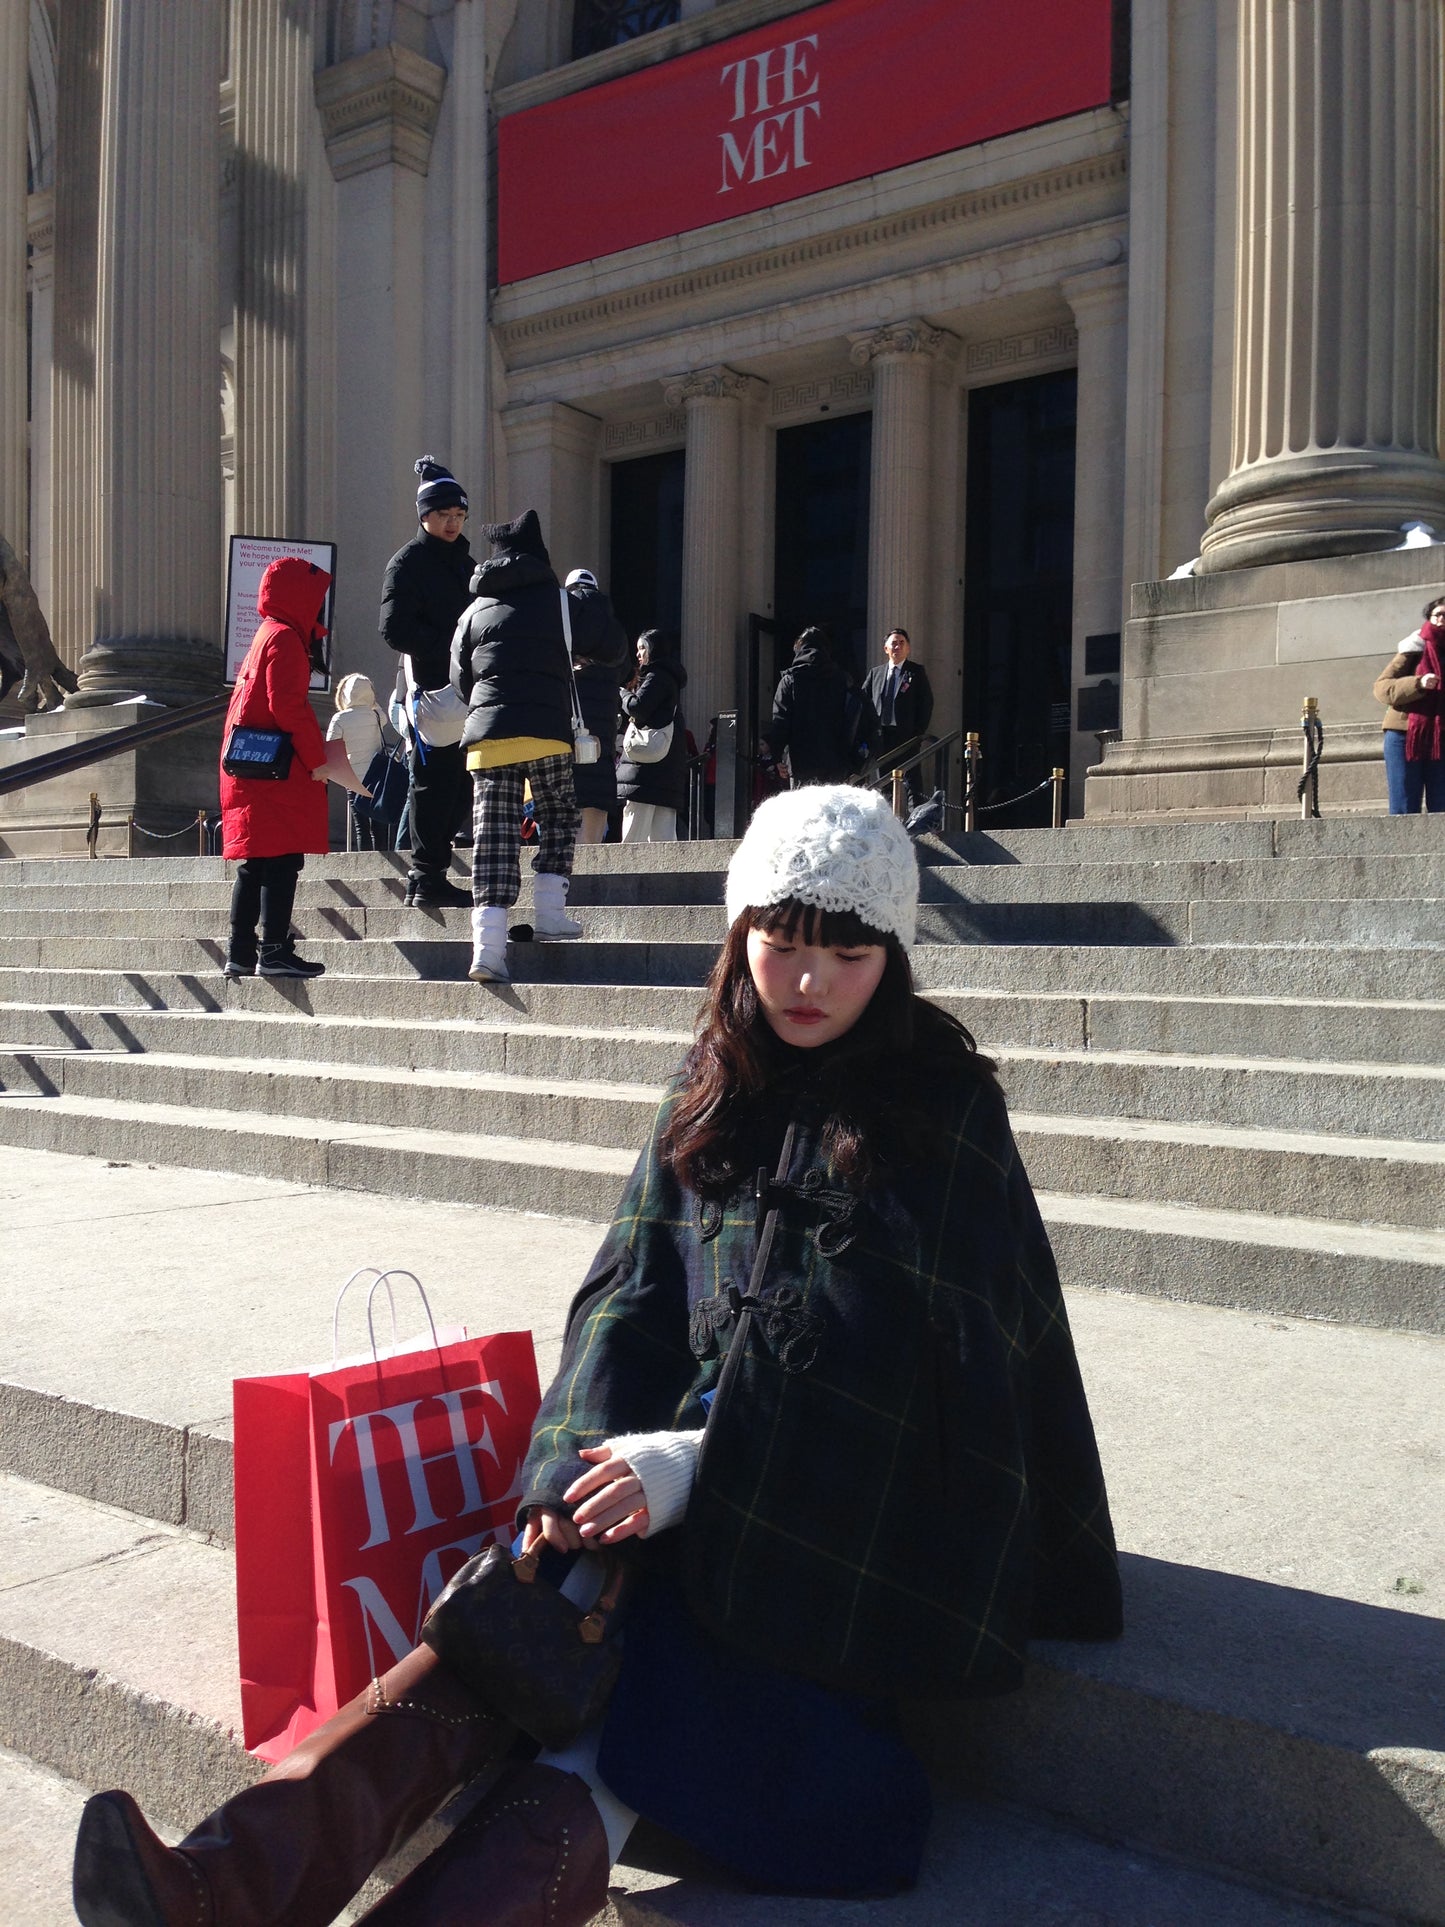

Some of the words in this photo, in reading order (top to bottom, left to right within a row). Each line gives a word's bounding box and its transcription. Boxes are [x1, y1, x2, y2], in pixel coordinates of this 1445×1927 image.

[720, 34, 819, 122] THE
[716, 101, 820, 194] MET
[240, 543, 273, 551] Welcome
[283, 546, 296, 554] The
[297, 547, 313, 555] Met!
[252, 552, 270, 560] hope
[328, 1379, 523, 1551] THE
